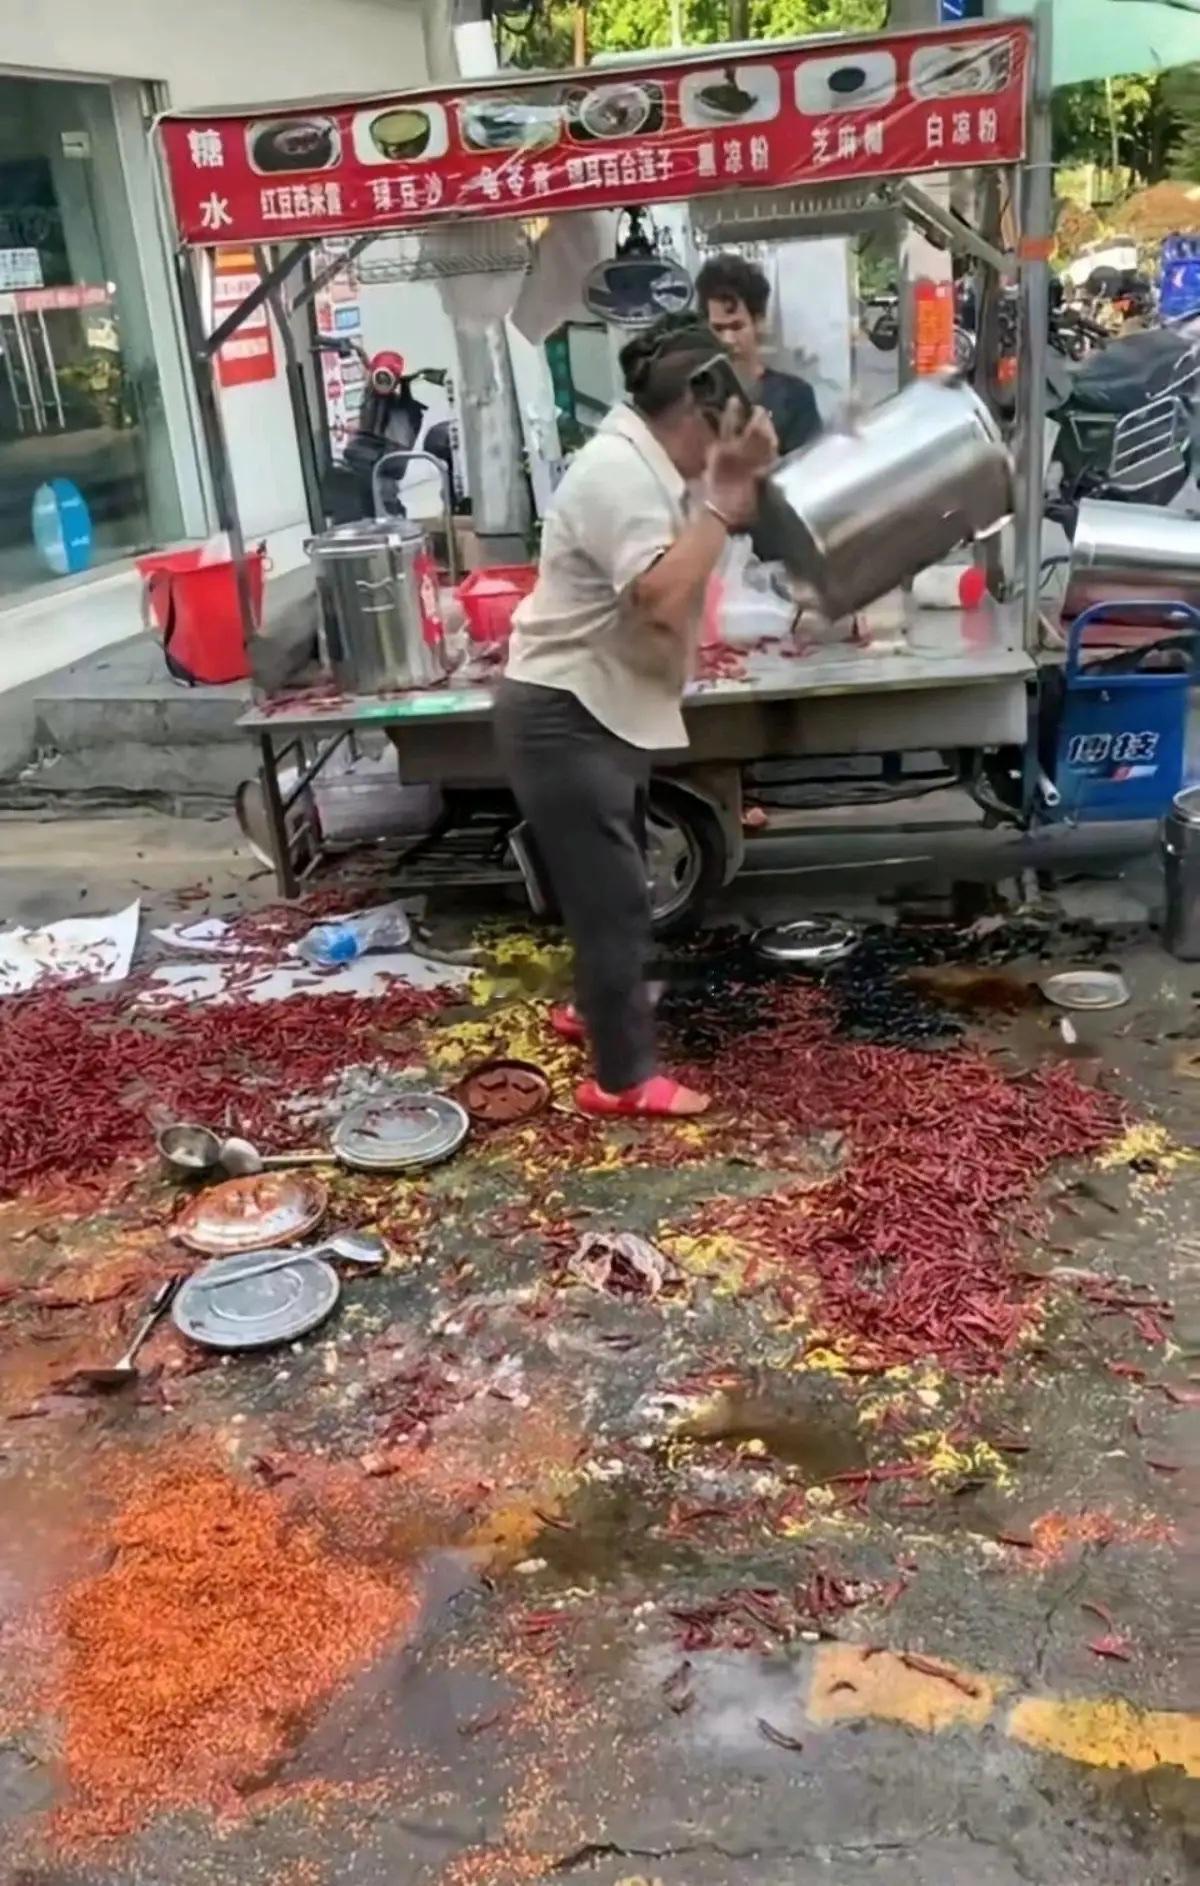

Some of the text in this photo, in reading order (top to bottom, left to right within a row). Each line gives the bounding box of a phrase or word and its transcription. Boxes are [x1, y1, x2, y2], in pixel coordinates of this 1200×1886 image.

[927, 110, 998, 149] 白凉粉
[187, 128, 233, 230] 糖水
